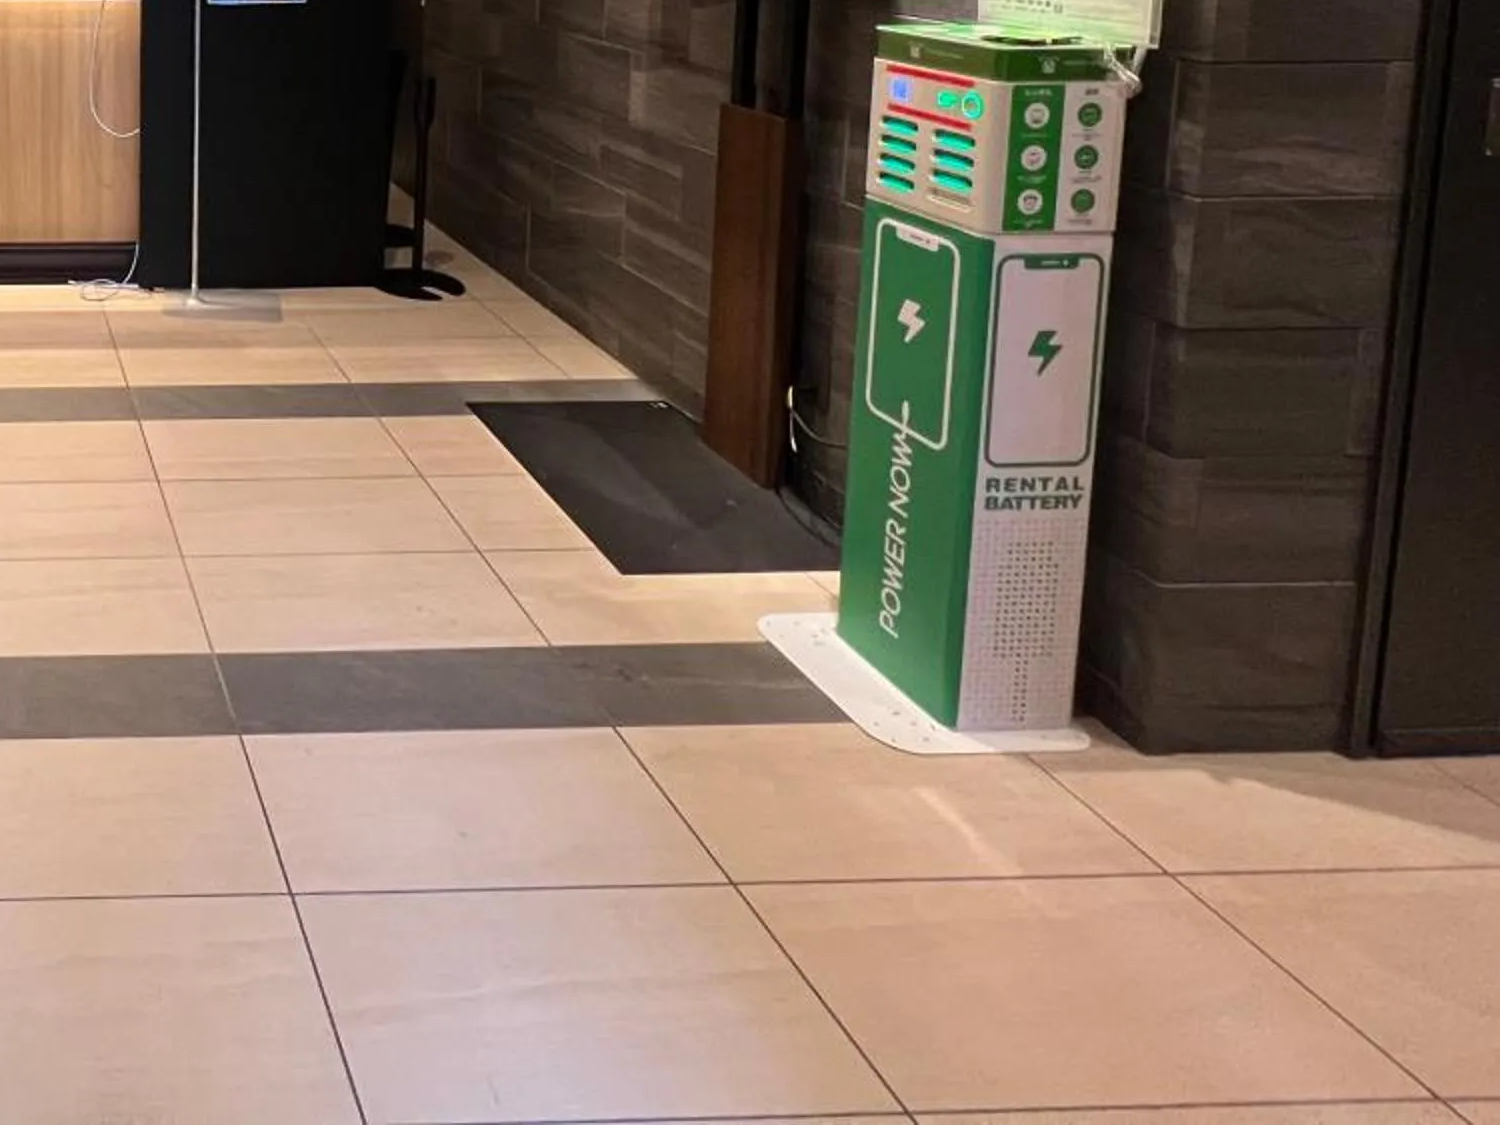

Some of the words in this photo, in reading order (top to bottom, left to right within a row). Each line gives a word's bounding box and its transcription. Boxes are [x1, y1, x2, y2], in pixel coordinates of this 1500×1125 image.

[985, 476, 1085, 493] RENTAL
[984, 493, 1083, 512] BATTERY
[879, 518, 908, 639] POWER
